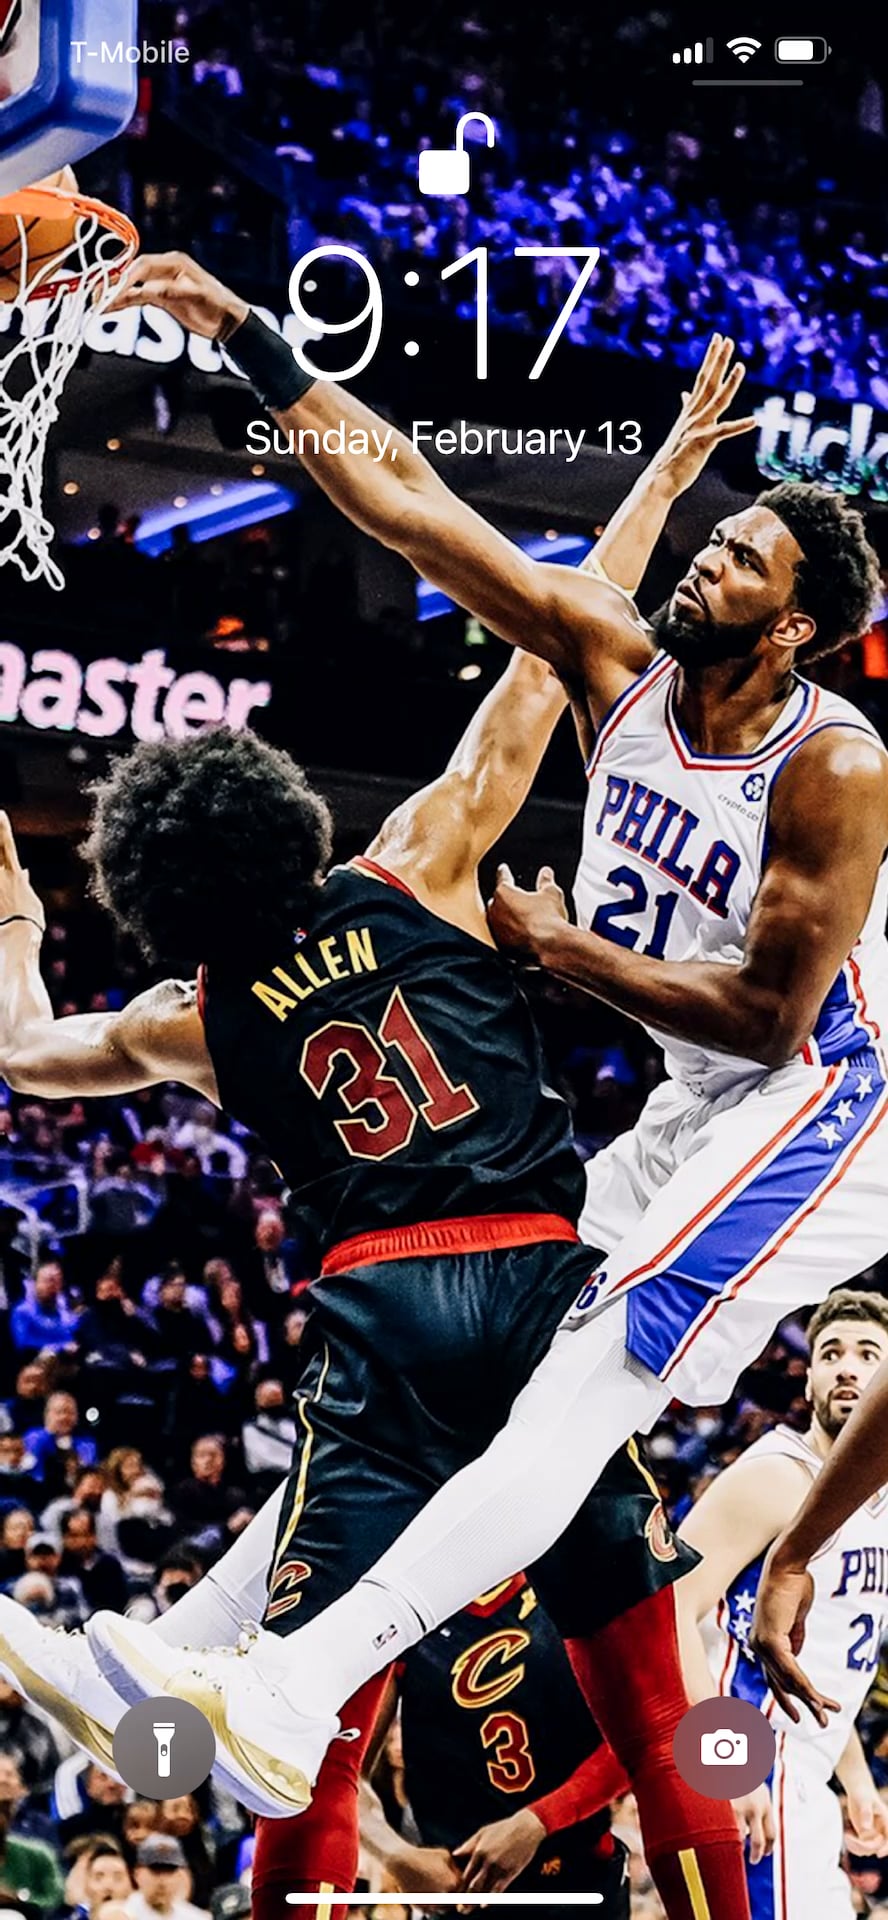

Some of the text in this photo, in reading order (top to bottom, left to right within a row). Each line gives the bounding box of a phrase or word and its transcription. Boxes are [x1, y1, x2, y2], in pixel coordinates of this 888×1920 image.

[595, 773, 742, 919] PHILA
[590, 864, 679, 960] 21
[250, 927, 378, 1023] ALLEN
[299, 984, 481, 1162] 31
[830, 1546, 888, 1598] PHI
[451, 1627, 532, 1709] C
[479, 1710, 537, 1794] 3
